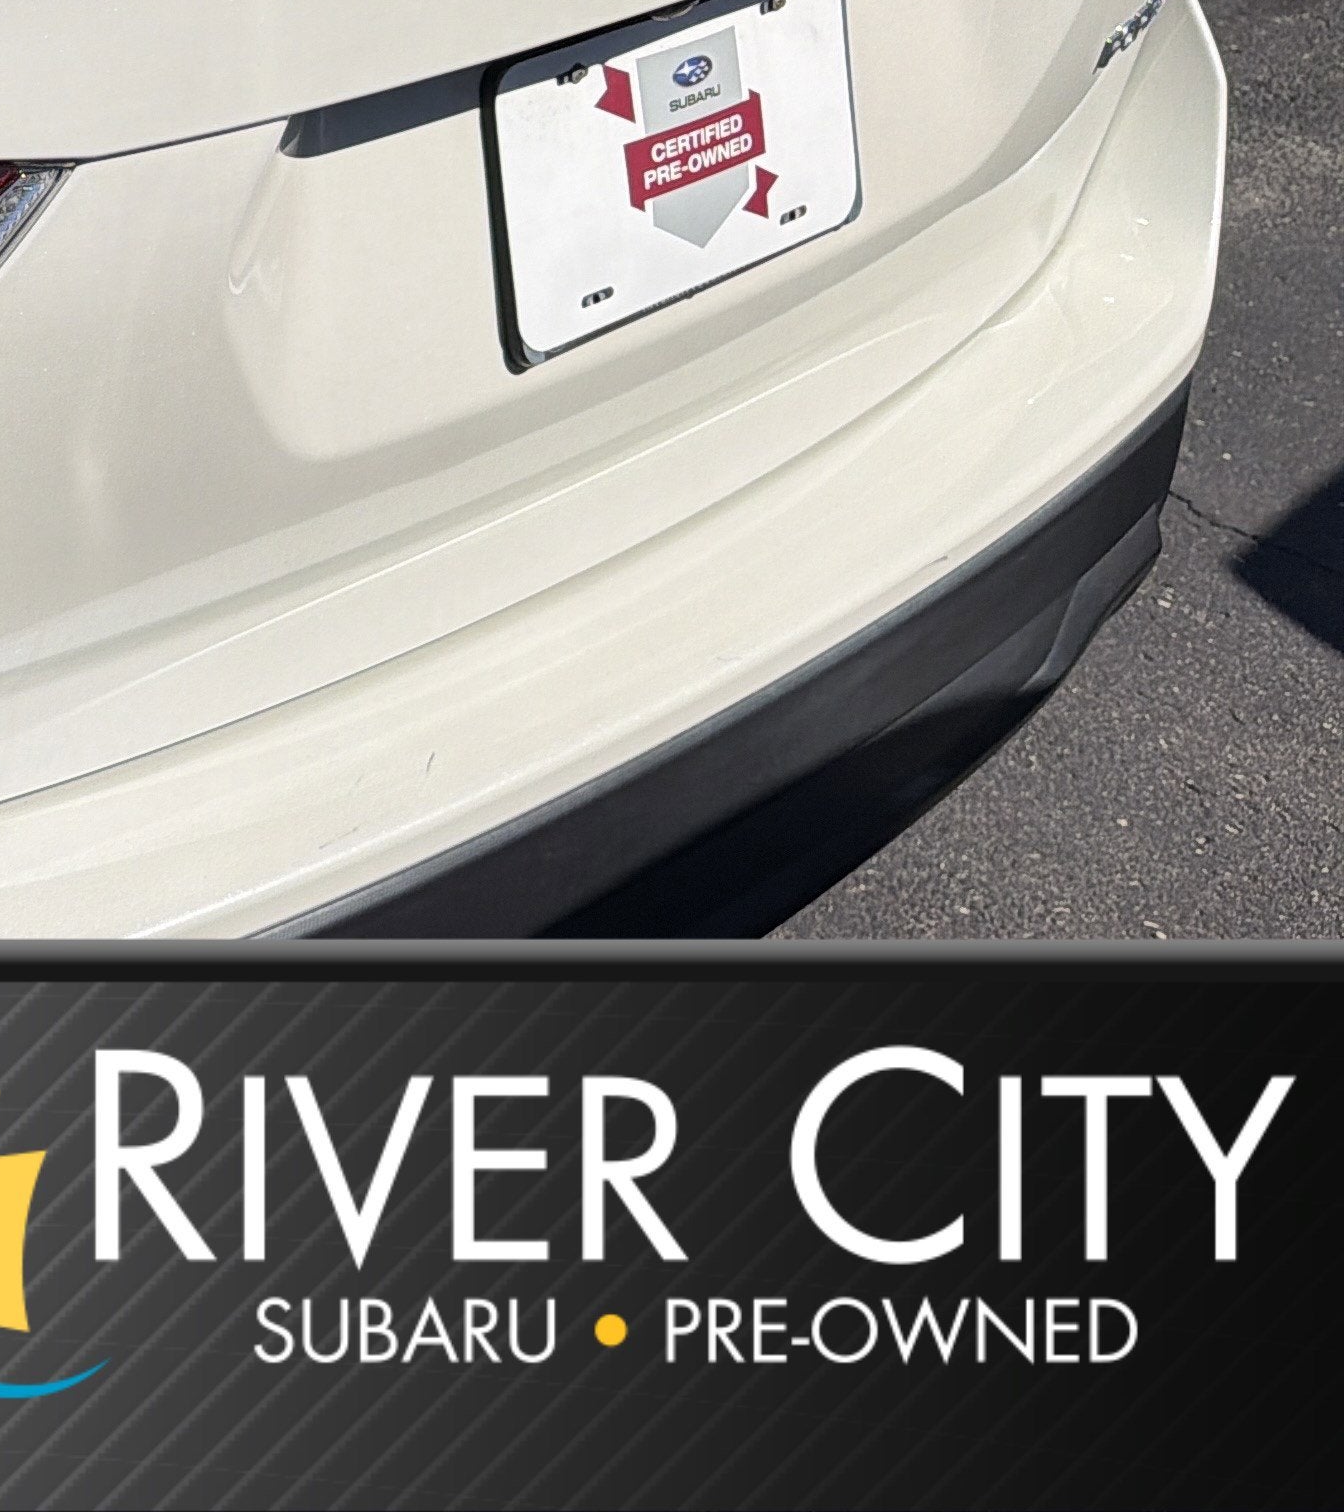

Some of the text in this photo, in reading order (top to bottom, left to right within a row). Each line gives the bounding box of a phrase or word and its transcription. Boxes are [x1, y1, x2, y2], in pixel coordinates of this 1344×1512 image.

[668, 84, 721, 112] SUBARU
[643, 133, 753, 190] PRE-OWNED
[651, 113, 743, 163] CERTIFIED
